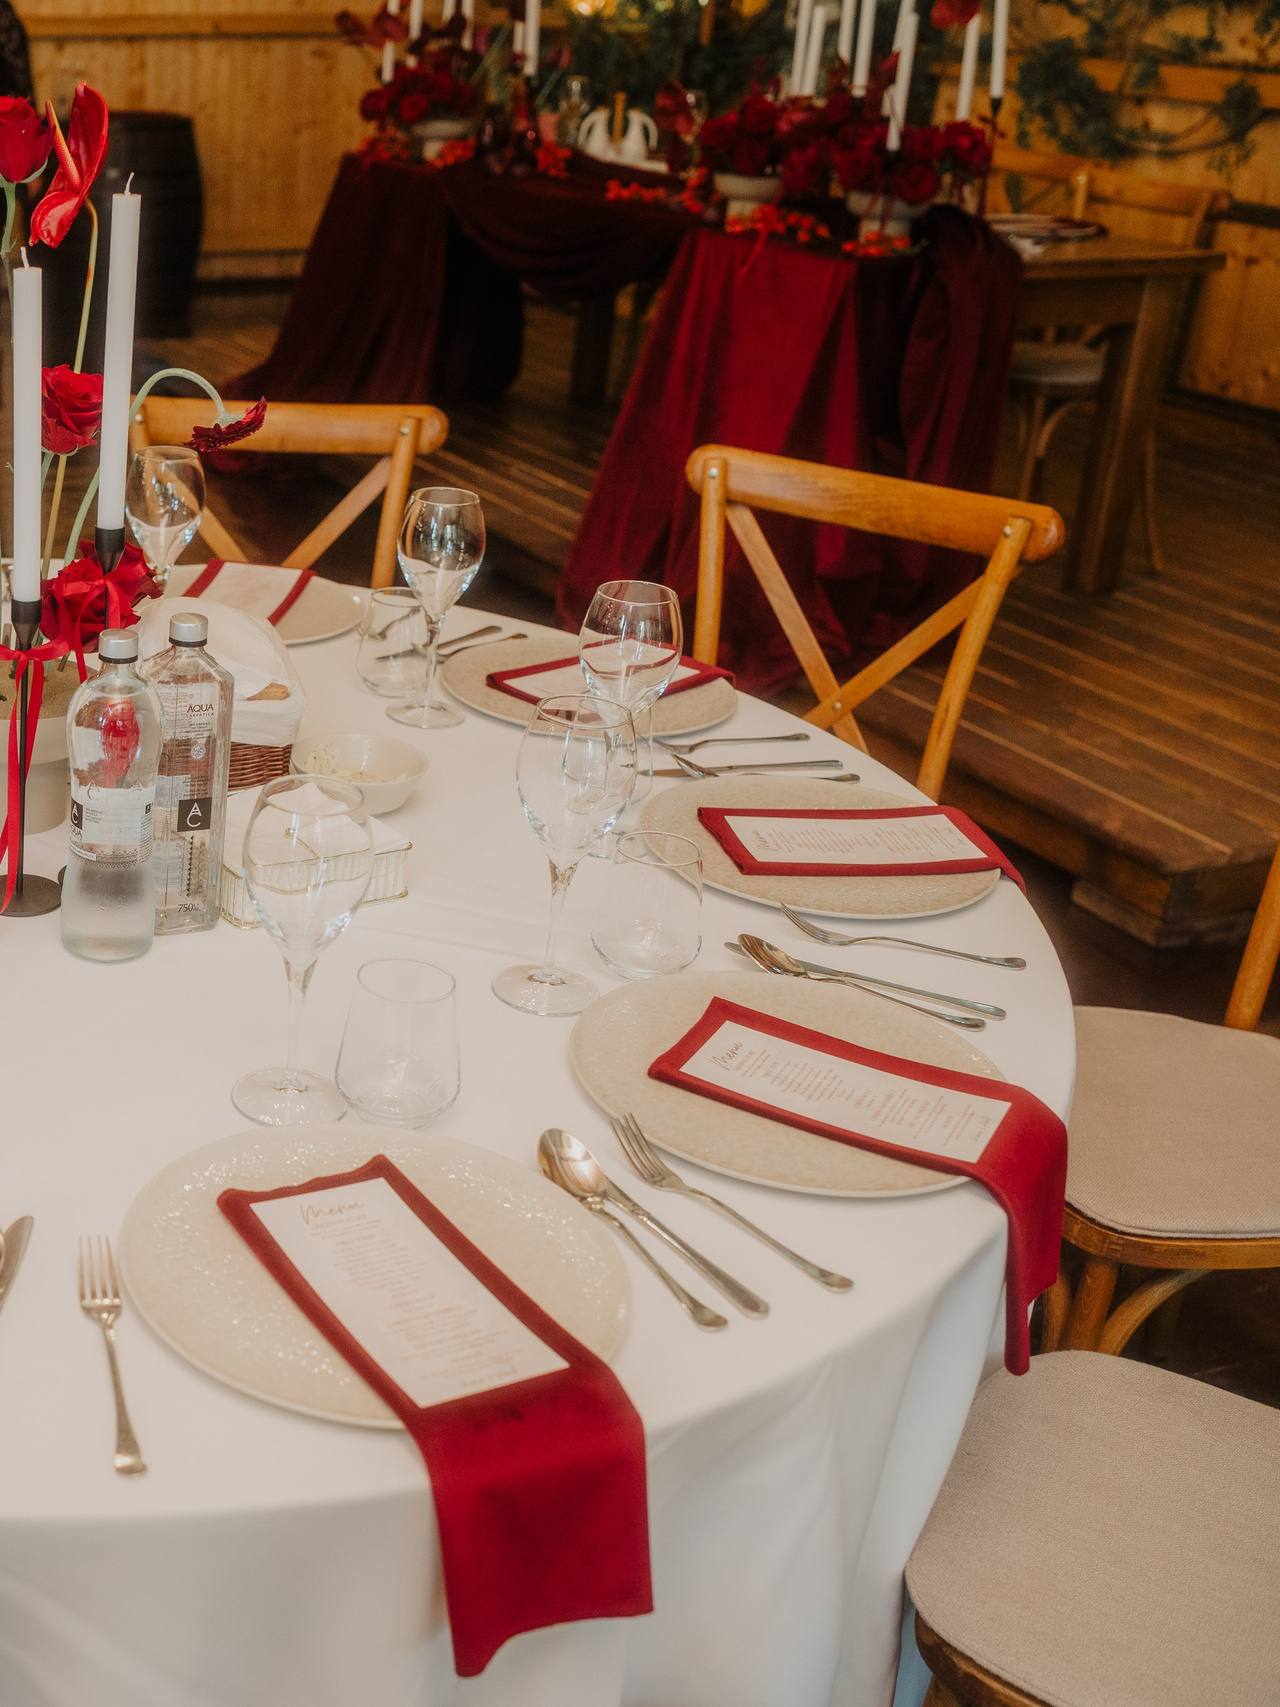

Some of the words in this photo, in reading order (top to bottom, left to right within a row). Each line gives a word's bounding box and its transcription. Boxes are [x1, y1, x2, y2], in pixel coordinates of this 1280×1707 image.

[186, 703, 214, 713] AQUA
[706, 1042, 743, 1071] Menu
[299, 1202, 364, 1225] Menu
